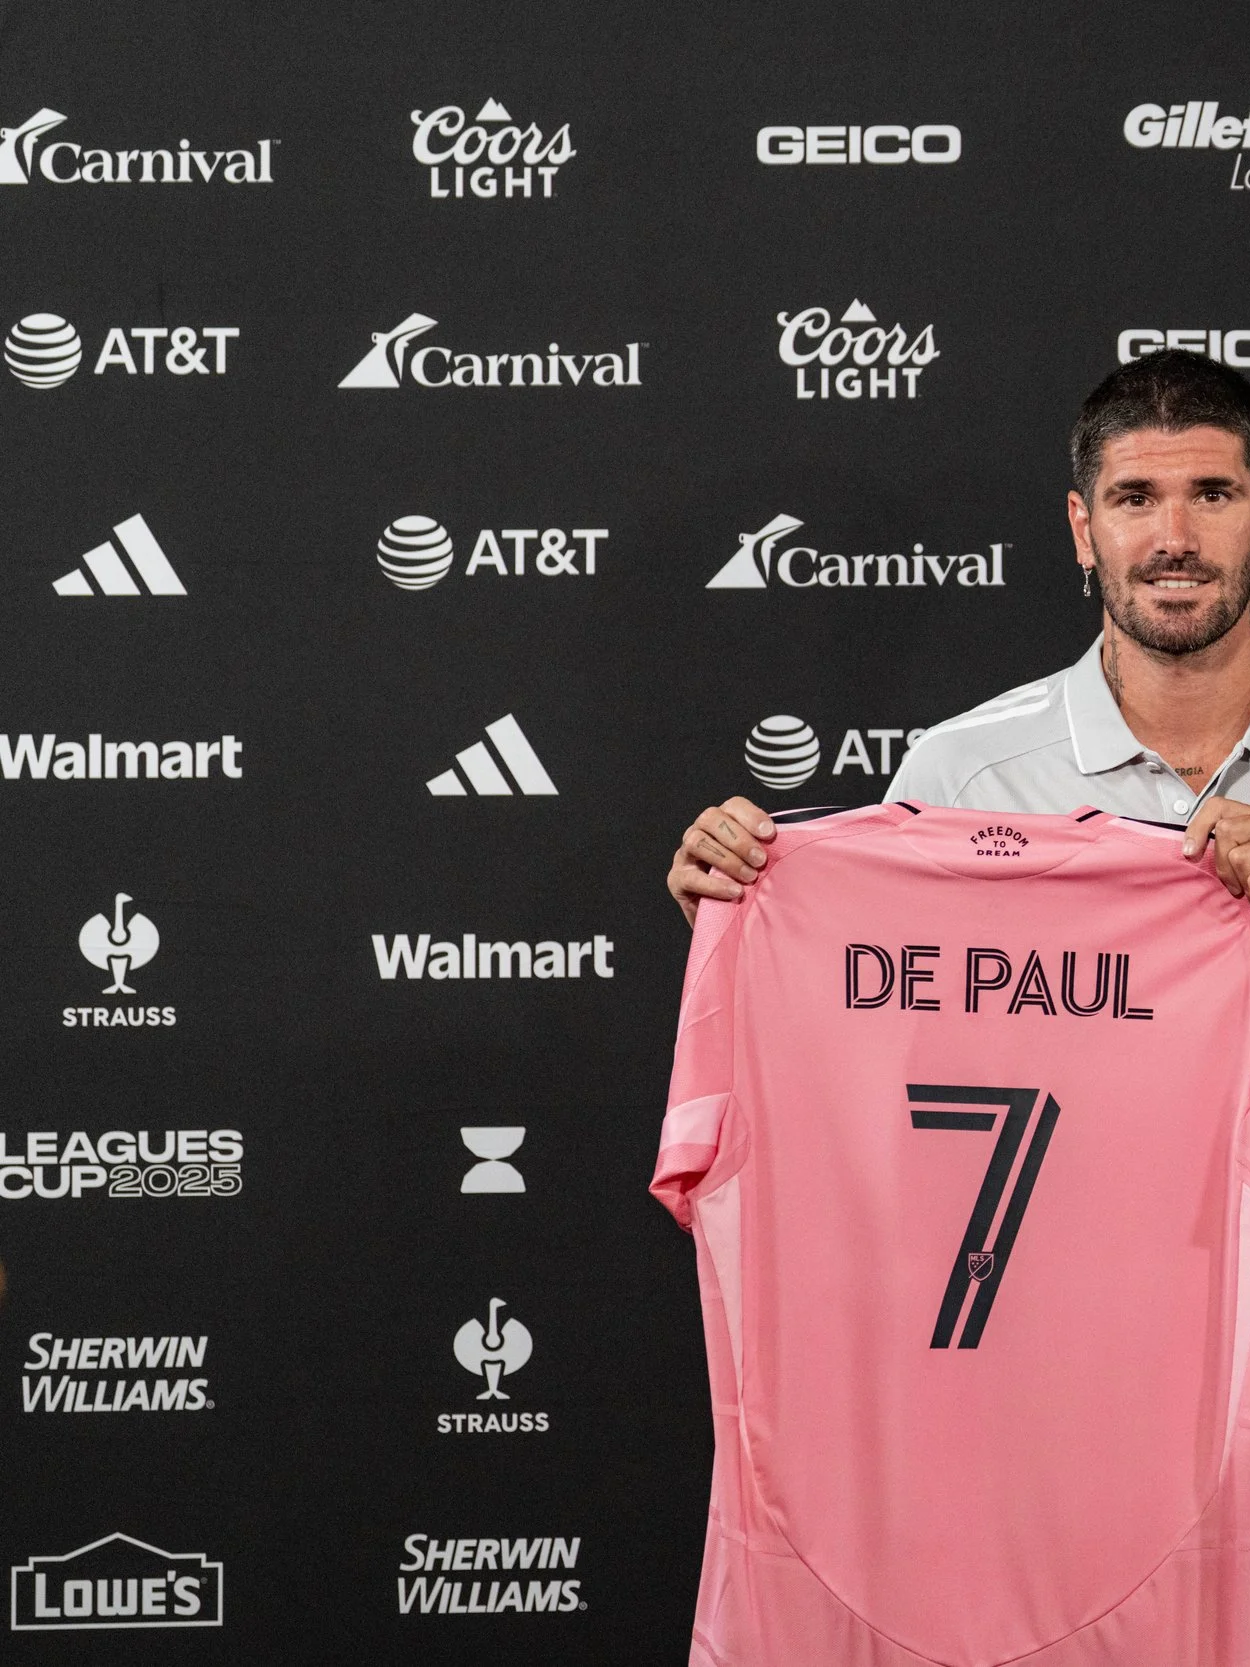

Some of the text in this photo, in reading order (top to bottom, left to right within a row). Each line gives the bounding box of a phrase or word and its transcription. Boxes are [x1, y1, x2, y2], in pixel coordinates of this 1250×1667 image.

[410, 105, 577, 165] Coors
[758, 126, 962, 166] GEICO
[39, 138, 274, 184] Carnival
[431, 167, 559, 198] LIGHT
[95, 328, 241, 376] AT&T
[776, 306, 941, 366] Coors
[409, 342, 643, 388] Carnival
[798, 369, 924, 400] LIGHT
[466, 529, 610, 577] AT&T
[777, 543, 1006, 588] Carnival
[0, 735, 243, 781] Walmart
[832, 728, 927, 776] AT
[970, 825, 1029, 847] FREEDOM
[977, 849, 1020, 857] DREAM
[993, 840, 1006, 848] TO
[373, 935, 615, 981] Walmart
[845, 943, 1154, 1020] DE PAUL
[64, 1008, 177, 1028] STRAUSS
[0, 1130, 244, 1165] LEAGUES
[0, 1164, 242, 1199] CUP 2025
[906, 1084, 1061, 1349] 7
[25, 1334, 209, 1371] SHERWIN
[23, 1376, 206, 1413] WILLIAMS
[439, 1414, 550, 1434] STRAUSS
[401, 1535, 581, 1572] SHERWIN
[34, 1570, 202, 1618] LOWE'S
[399, 1578, 580, 1614] WILLIAMS
